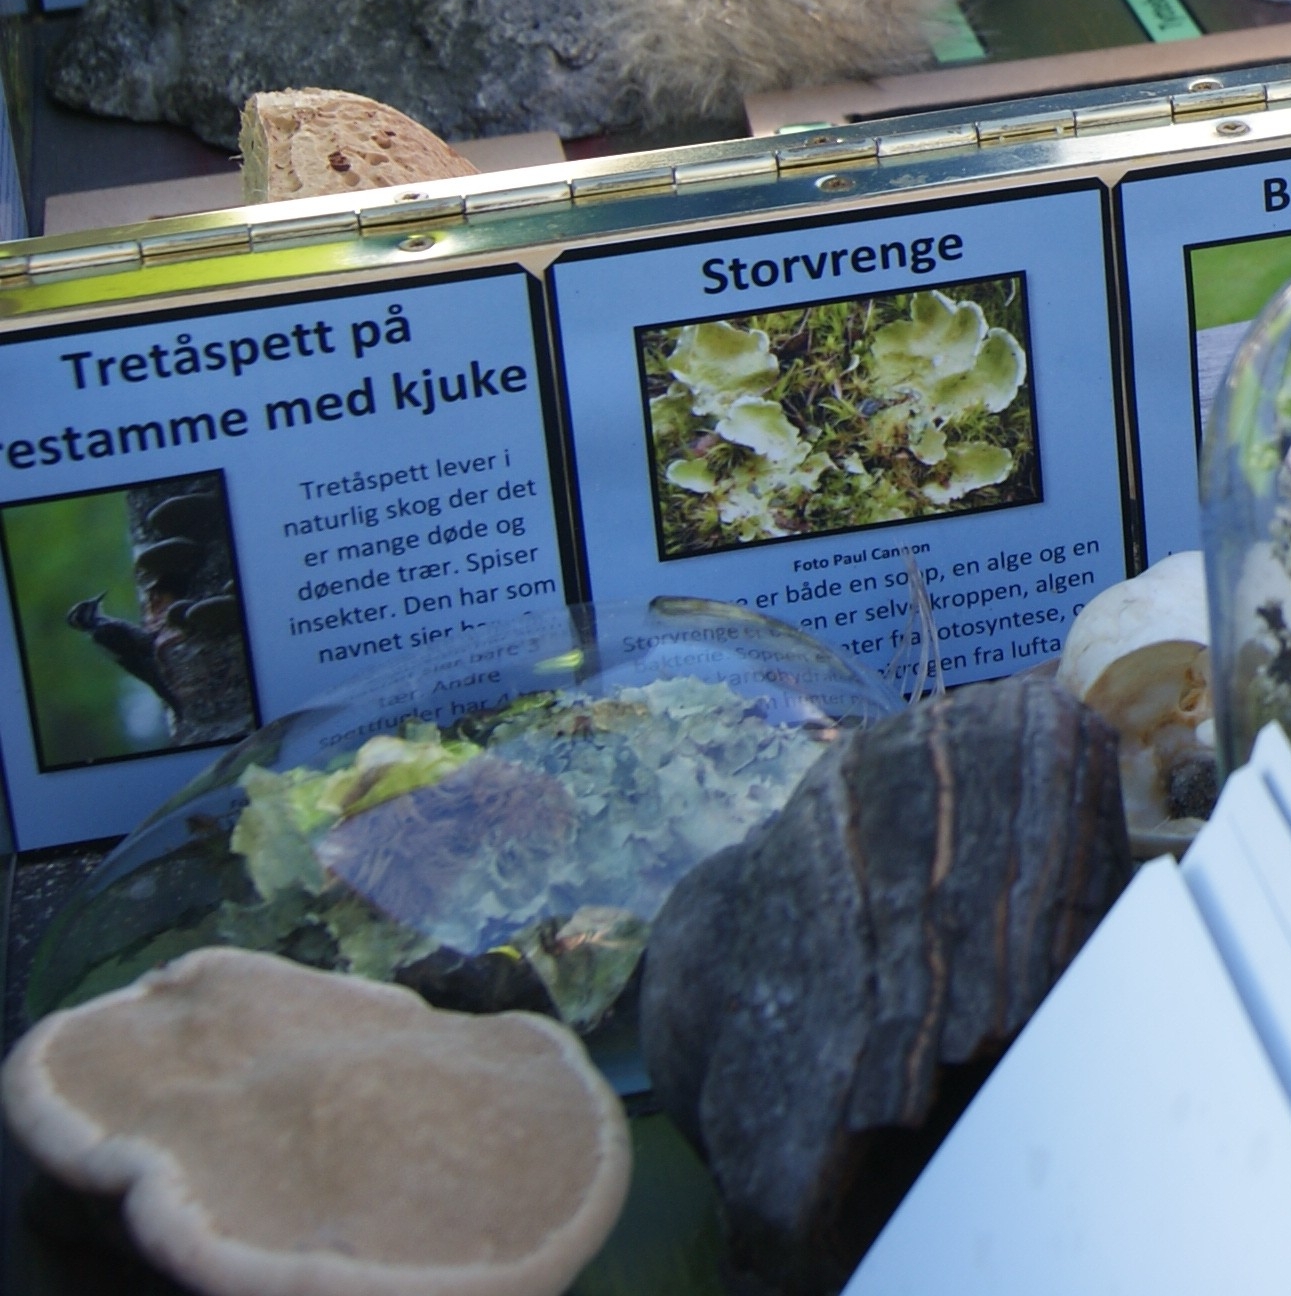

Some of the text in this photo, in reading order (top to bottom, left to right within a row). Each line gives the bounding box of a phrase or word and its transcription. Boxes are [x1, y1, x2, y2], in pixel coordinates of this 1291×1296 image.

[702, 233, 963, 294] Storvrenge
[60, 303, 411, 389] Tretåspett på
[265, 376, 375, 430] med
[392, 360, 526, 415] kjuke
[299, 448, 510, 499] Tretåspett lever i
[283, 479, 536, 537] naturlig skog der det
[304, 516, 525, 566] er mange døde og
[793, 558, 829, 572] Foto
[833, 549, 866, 565] Paul
[297, 547, 538, 600] døende trær. Spiser
[755, 590, 779, 608] er
[786, 576, 842, 603] både
[849, 576, 877, 593] en
[884, 567, 944, 587] sop,
[952, 560, 979, 576] en
[987, 551, 1032, 572] alge
[1039, 545, 1065, 563] og
[1072, 540, 1099, 556] en
[834, 610, 857, 626] er
[929, 583, 1028, 610] kroppen,
[1036, 571, 1094, 593] algen
[289, 578, 555, 635] insekter. Den har som
[931, 607, 1065, 641] otosyntese,
[318, 633, 402, 663] navnet
[973, 646, 1003, 664] fra
[1011, 636, 1062, 658] lufta
